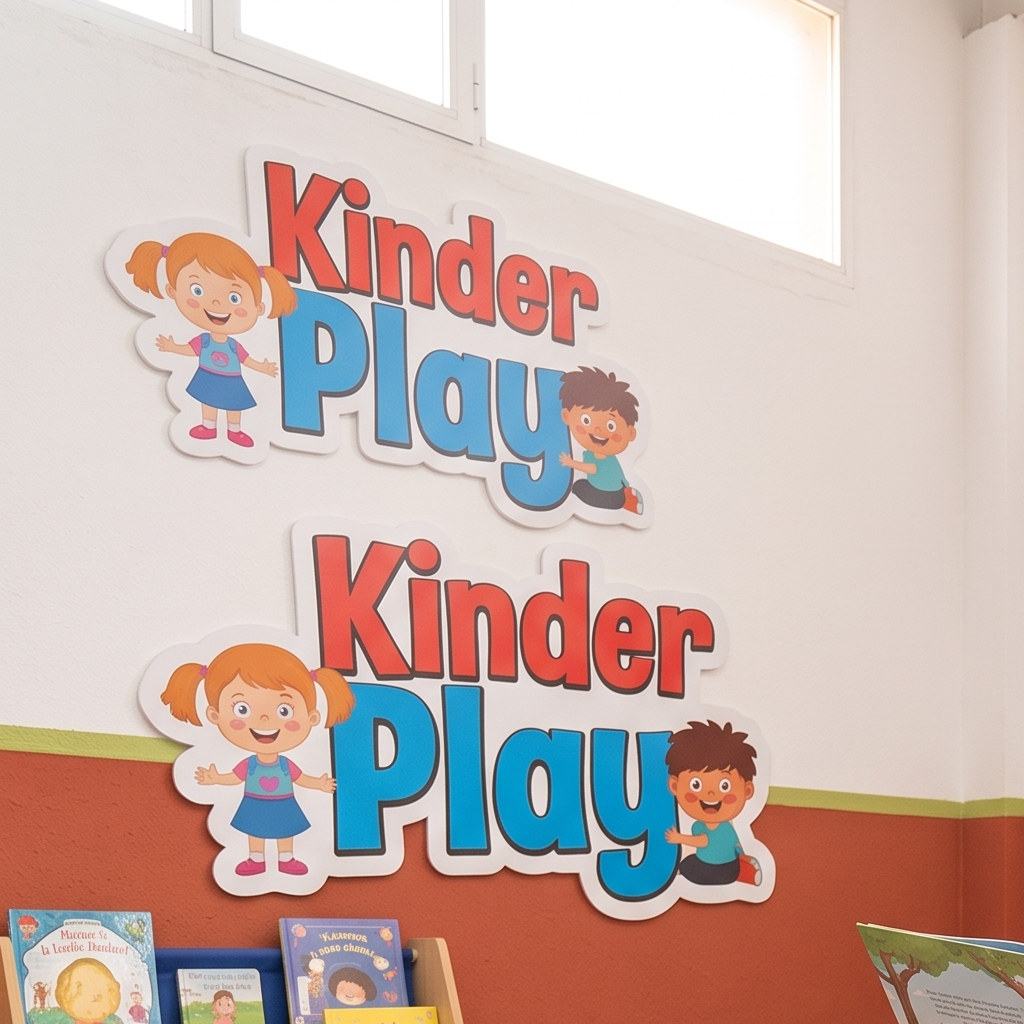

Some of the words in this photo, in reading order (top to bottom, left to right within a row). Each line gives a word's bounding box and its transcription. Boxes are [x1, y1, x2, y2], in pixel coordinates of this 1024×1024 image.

[263, 161, 600, 346] Kinder
[278, 288, 575, 511] Play
[312, 535, 715, 700] Kinder
[329, 682, 682, 902] Play
